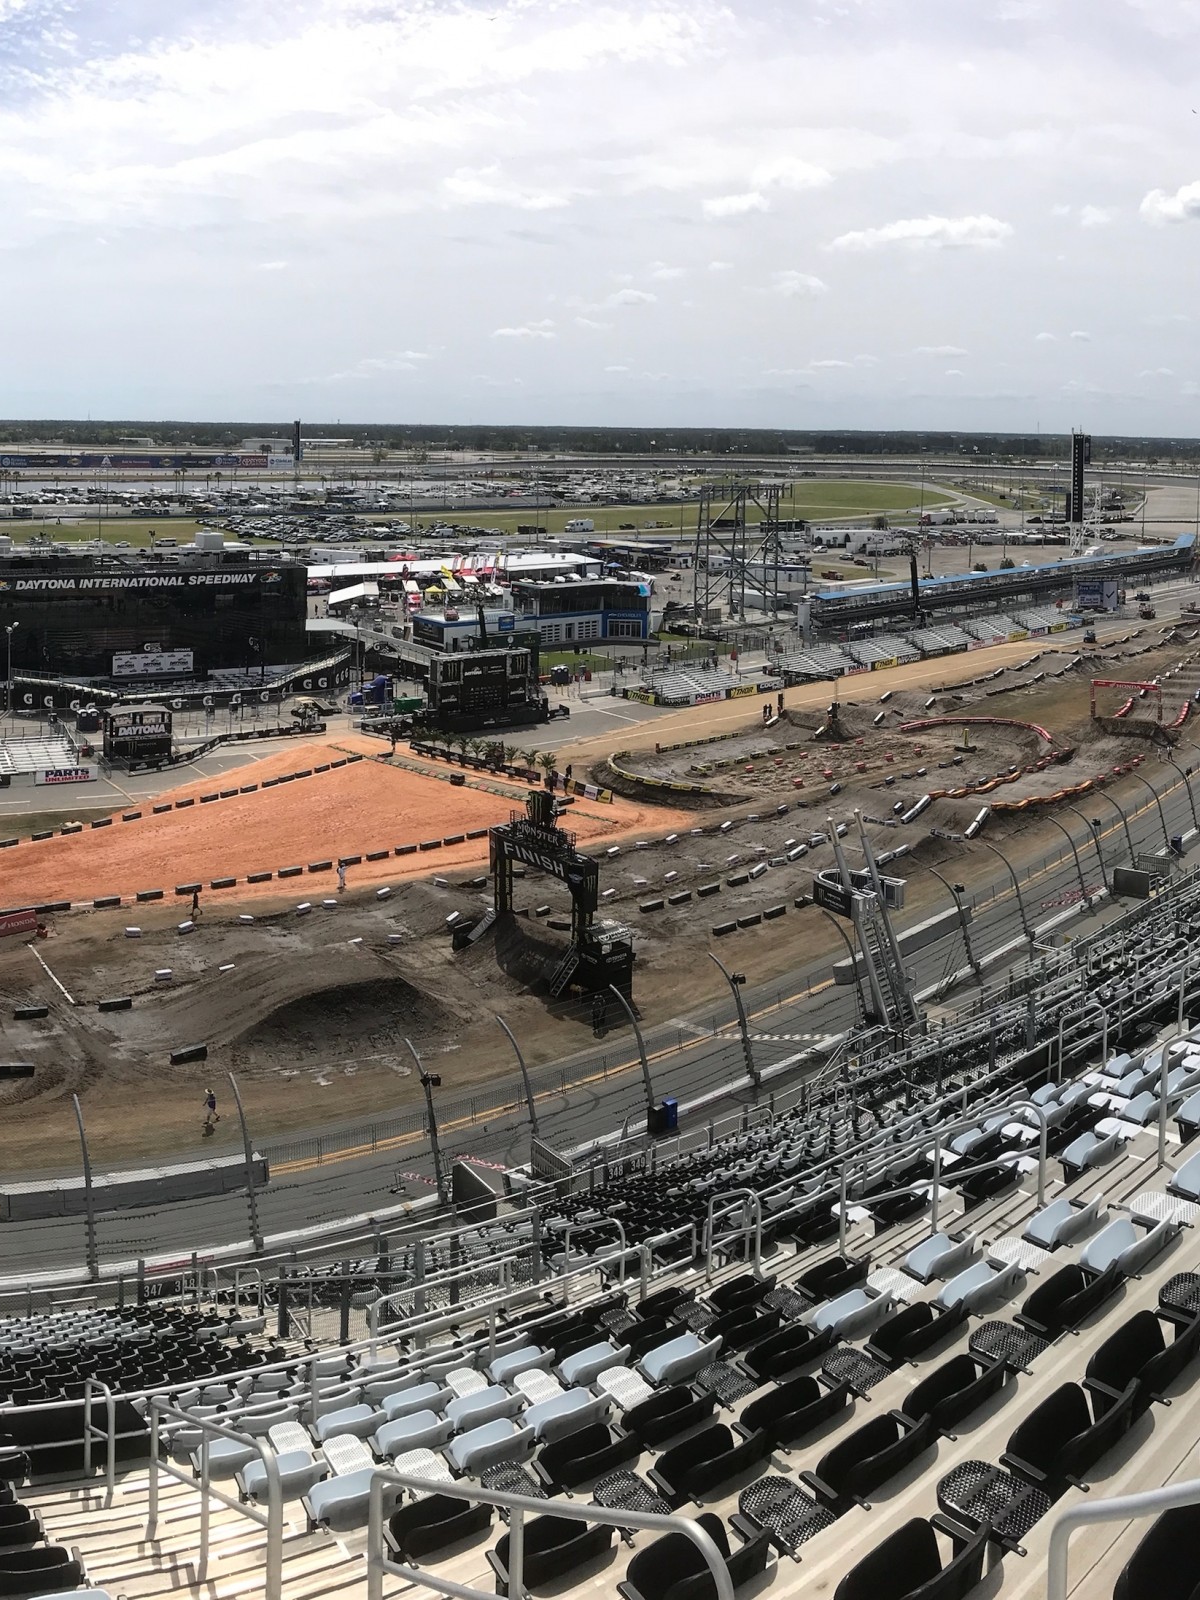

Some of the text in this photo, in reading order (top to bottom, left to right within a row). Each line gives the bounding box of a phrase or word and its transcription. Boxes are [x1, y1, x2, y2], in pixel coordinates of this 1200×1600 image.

[15, 573, 257, 591] DAYTONA INTERNATIONAL SPEEDWAY
[632, 692, 650, 701] THOR
[695, 691, 721, 700] PARTS
[736, 687, 754, 696] THOR
[118, 723, 166, 736] DAYTONA
[45, 768, 90, 778] PARTS
[45, 775, 90, 783] UNLIMITED
[517, 823, 560, 846] MONSTER
[503, 841, 565, 878] FINISH
[7, 918, 36, 929] HONDA
[608, 1156, 646, 1180] 348 349
[143, 1283, 163, 1298] 347
